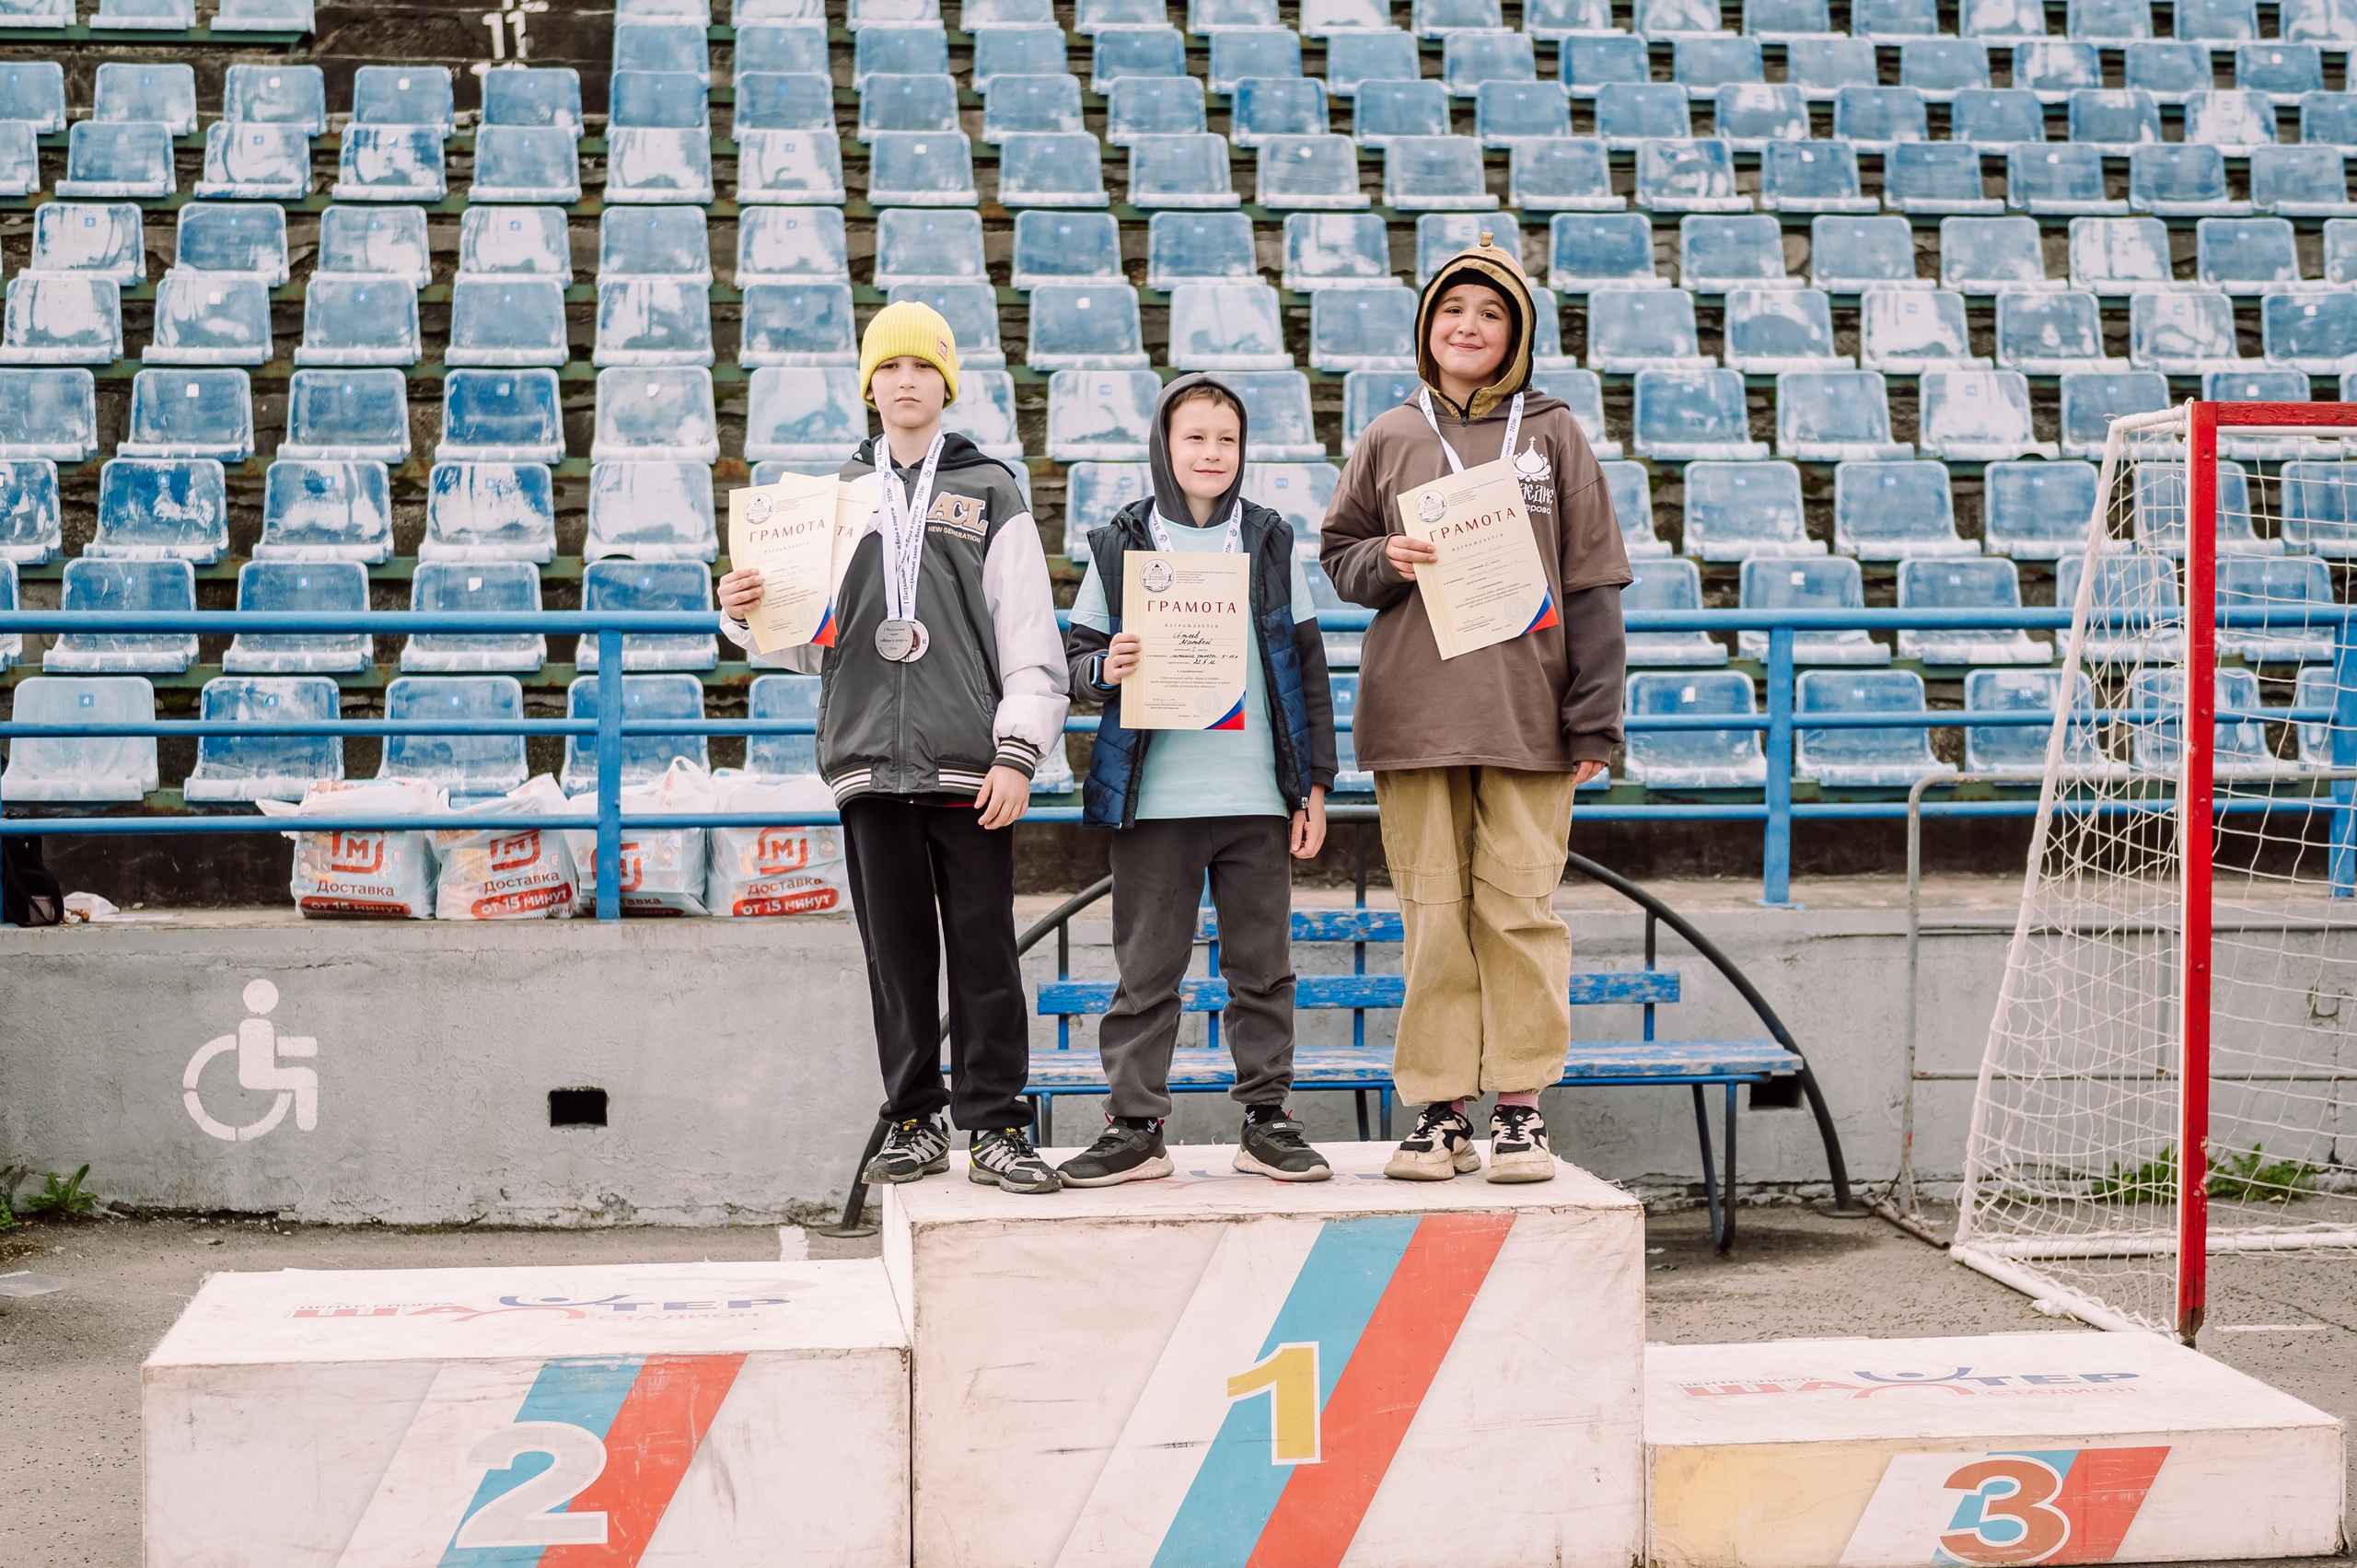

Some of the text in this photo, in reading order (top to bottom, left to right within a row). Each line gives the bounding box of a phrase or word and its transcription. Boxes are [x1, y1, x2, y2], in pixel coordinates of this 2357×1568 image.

[482, 9, 527, 60] 11
[925, 492, 989, 536] ACL
[1526, 504, 1552, 515] ерово
[749, 518, 825, 543] ГРАМОТА
[943, 527, 981, 543] GENERATION
[1429, 507, 1516, 542] ГРАМОТА
[1451, 532, 1504, 552] НАГРАЖДАЕТСЯ
[1147, 600, 1237, 614] ГРАМОТА
[346, 839, 370, 860] М
[772, 838, 794, 860] М
[316, 879, 395, 897] Доставка
[483, 872, 560, 895] Доставка
[748, 877, 823, 896] Доставка
[310, 901, 401, 913] от 15 минут
[481, 889, 568, 915] от 15 минут
[589, 897, 663, 907] Дтавка
[742, 894, 831, 915] от 15 минут
[598, 1312, 760, 1321] СТАДИОН
[1986, 1387, 2139, 1396] СТАДИОН
[1226, 1342, 1323, 1466] 1
[454, 1420, 610, 1549] 2
[1938, 1453, 2072, 1565] 3
